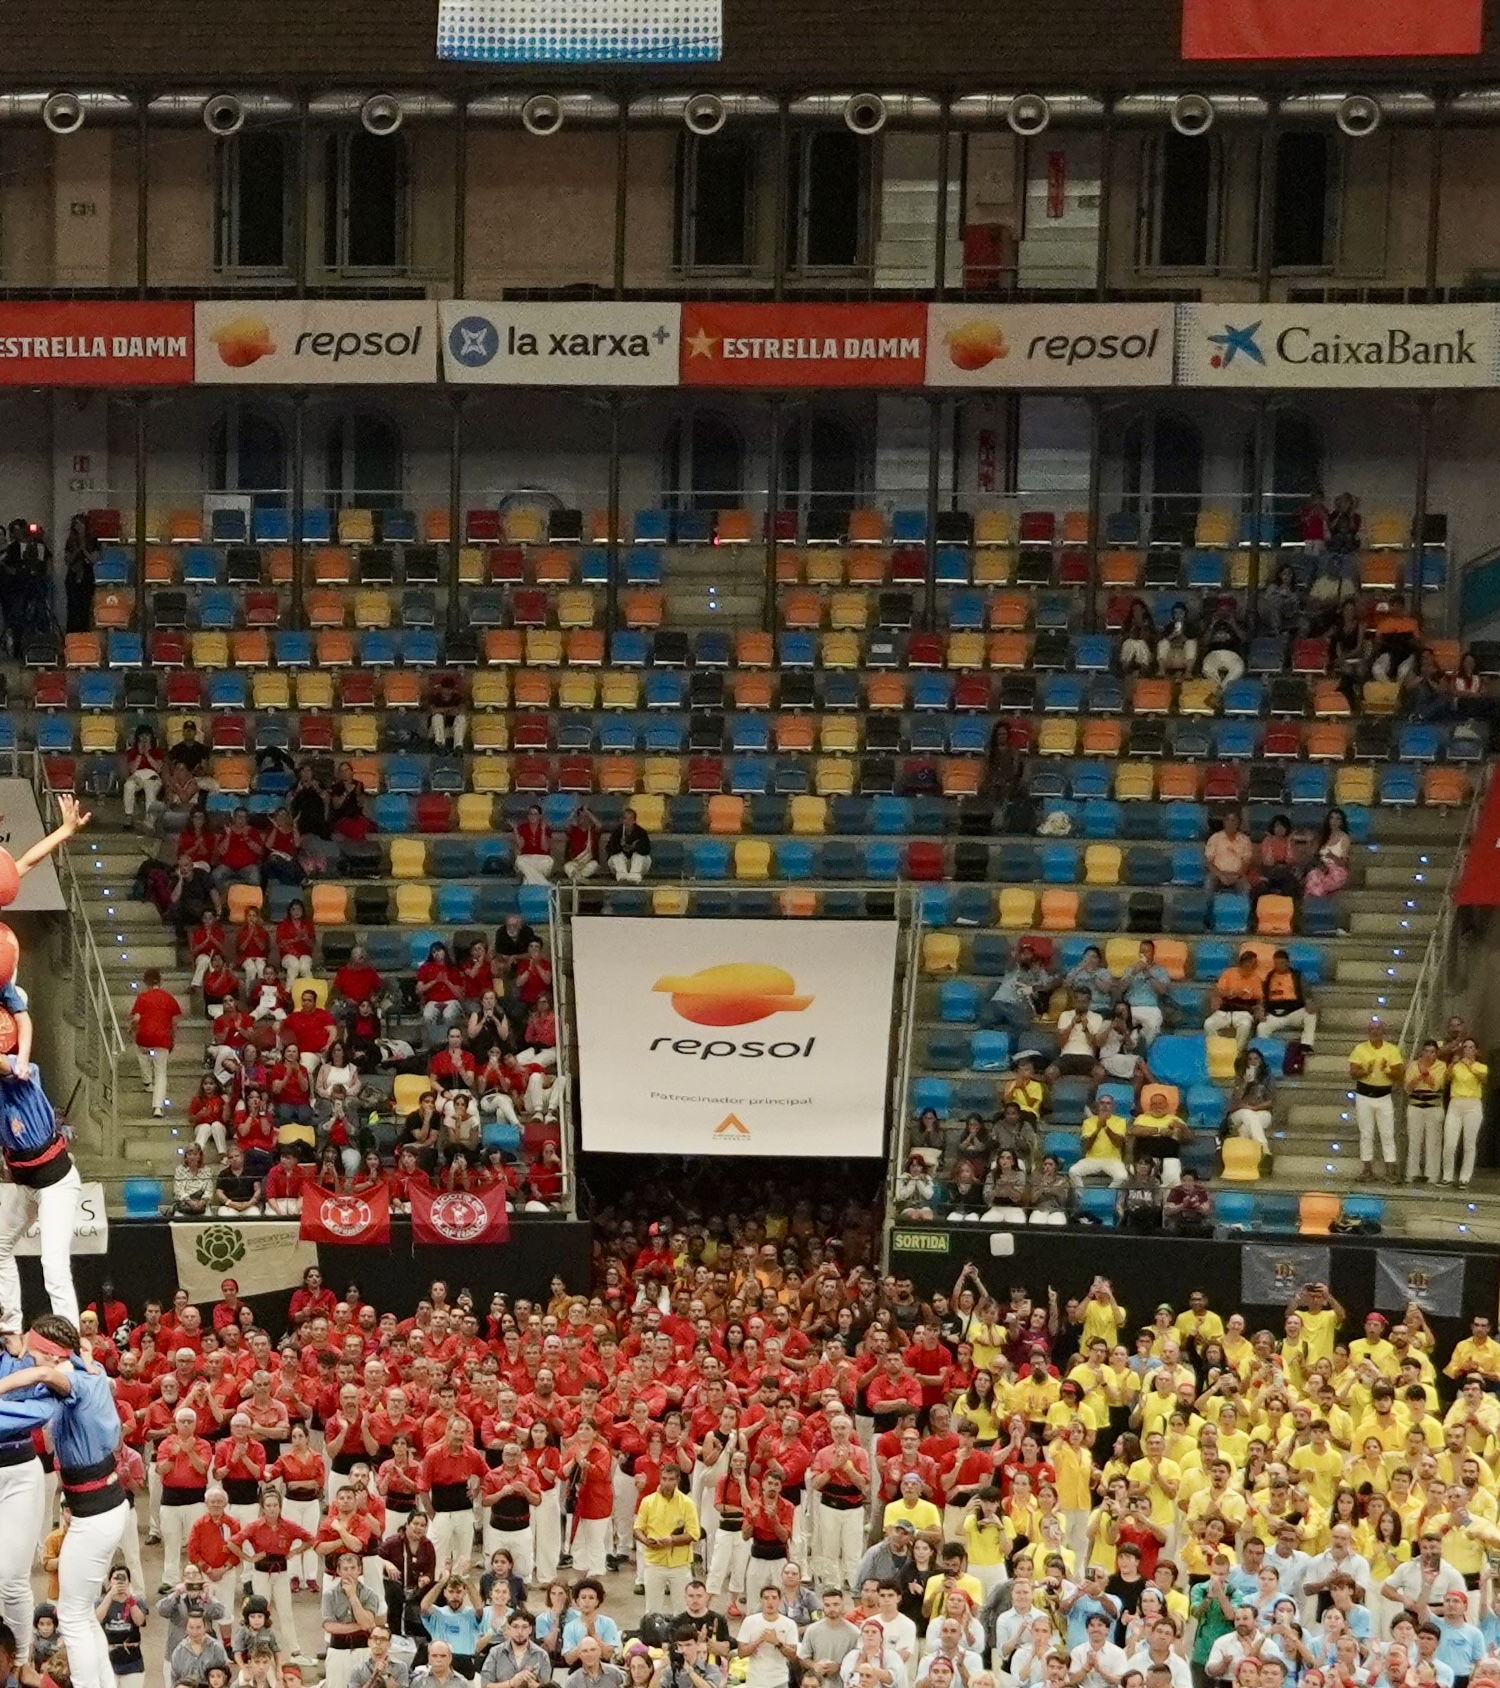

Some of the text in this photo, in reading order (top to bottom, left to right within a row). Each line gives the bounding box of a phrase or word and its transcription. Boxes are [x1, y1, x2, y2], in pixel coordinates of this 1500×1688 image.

[111, 336, 187, 358] DAMM
[294, 326, 422, 363] repsol
[507, 326, 542, 356] la
[723, 336, 921, 361] ESTRELLA DAMM
[1026, 329, 1160, 366] repsol
[1276, 325, 1478, 366] CaixaBank
[649, 1037, 816, 1061] repsol
[650, 1091, 814, 1106] Patrocinador principal
[895, 1234, 947, 1250] SORTIDA
